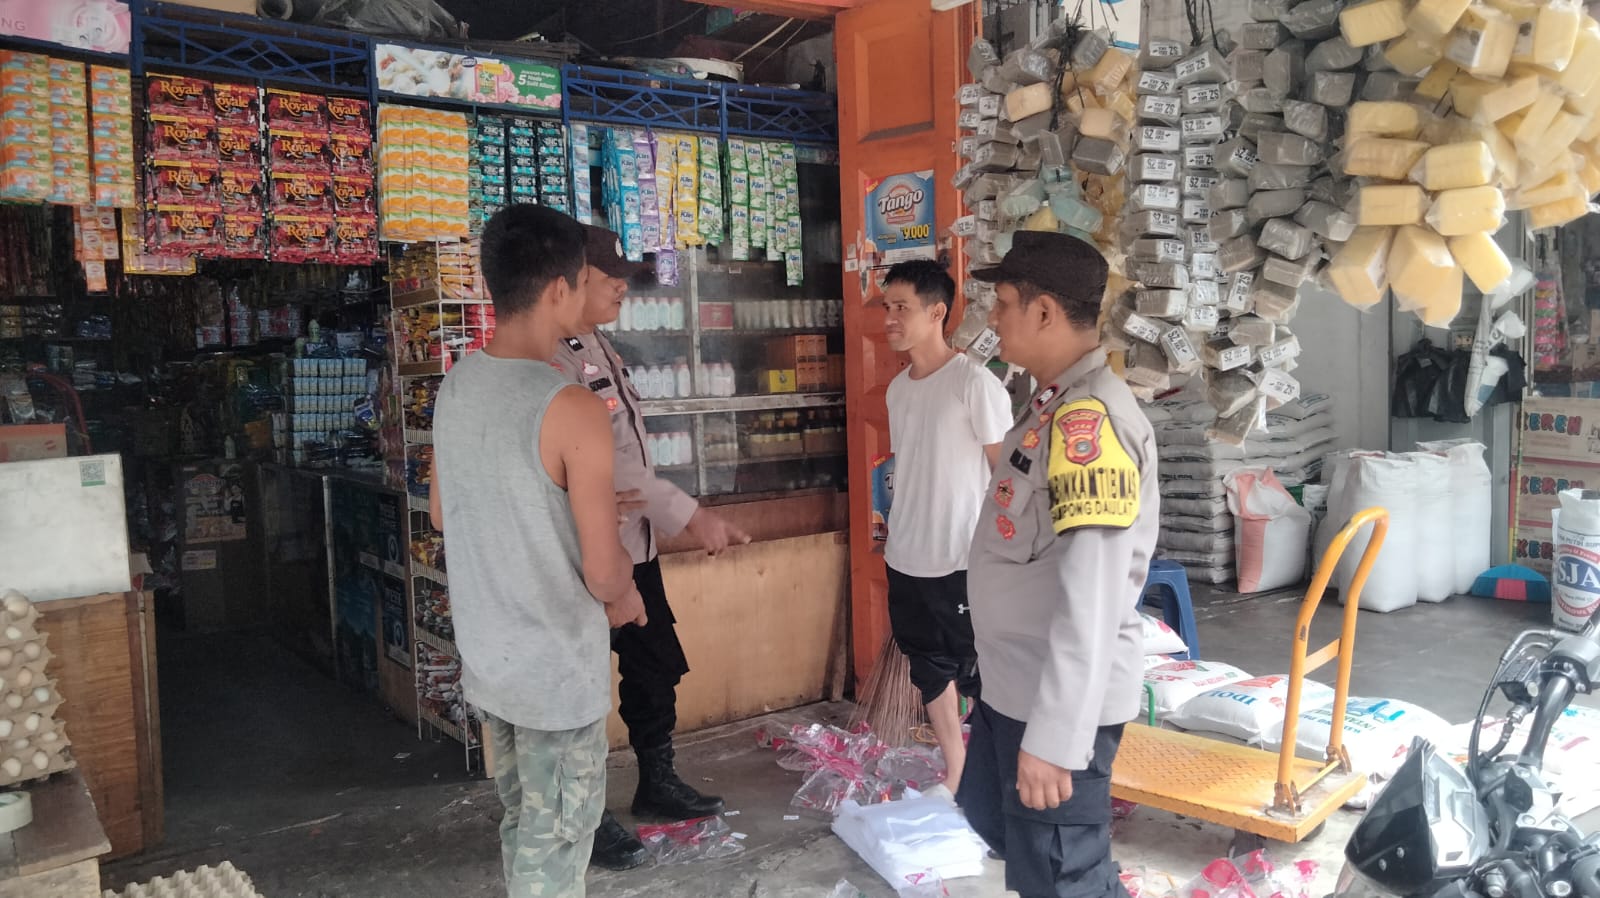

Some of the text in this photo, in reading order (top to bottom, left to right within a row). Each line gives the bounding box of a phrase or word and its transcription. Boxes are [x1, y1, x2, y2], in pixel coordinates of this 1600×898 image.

[0, 18, 25, 31] NG
[518, 75, 526, 85] 5
[160, 81, 202, 100] Royale
[280, 98, 318, 116] Royale
[164, 125, 206, 144] Royale
[678, 140, 692, 149] Klin
[701, 137, 714, 146] Klin
[282, 140, 320, 158] Royale
[730, 143, 744, 151] Klin
[635, 152, 650, 160] Klin
[748, 148, 761, 156] Klin
[782, 152, 793, 160] Klin
[621, 158, 634, 166] Klin
[168, 170, 210, 189] Royale
[679, 176, 693, 185] Klin
[703, 172, 715, 181] Klin
[733, 176, 746, 184] Klin
[751, 181, 764, 189] Klin
[285, 182, 324, 200] Royale
[775, 192, 786, 200] Klin
[878, 190, 923, 214] Tango
[680, 211, 694, 221] Klin
[702, 207, 713, 216] Klin
[734, 210, 746, 218] Klin
[752, 215, 765, 223] Klin
[171, 214, 213, 234] Royale
[288, 224, 325, 242] Royale
[643, 225, 657, 233] Klin
[788, 253, 800, 262] Klin
[1516, 411, 1582, 435] KEREN
[1096, 501, 1134, 516] DAULAT
[1559, 561, 1600, 589] SJA
[1205, 690, 1257, 705] IDOL
